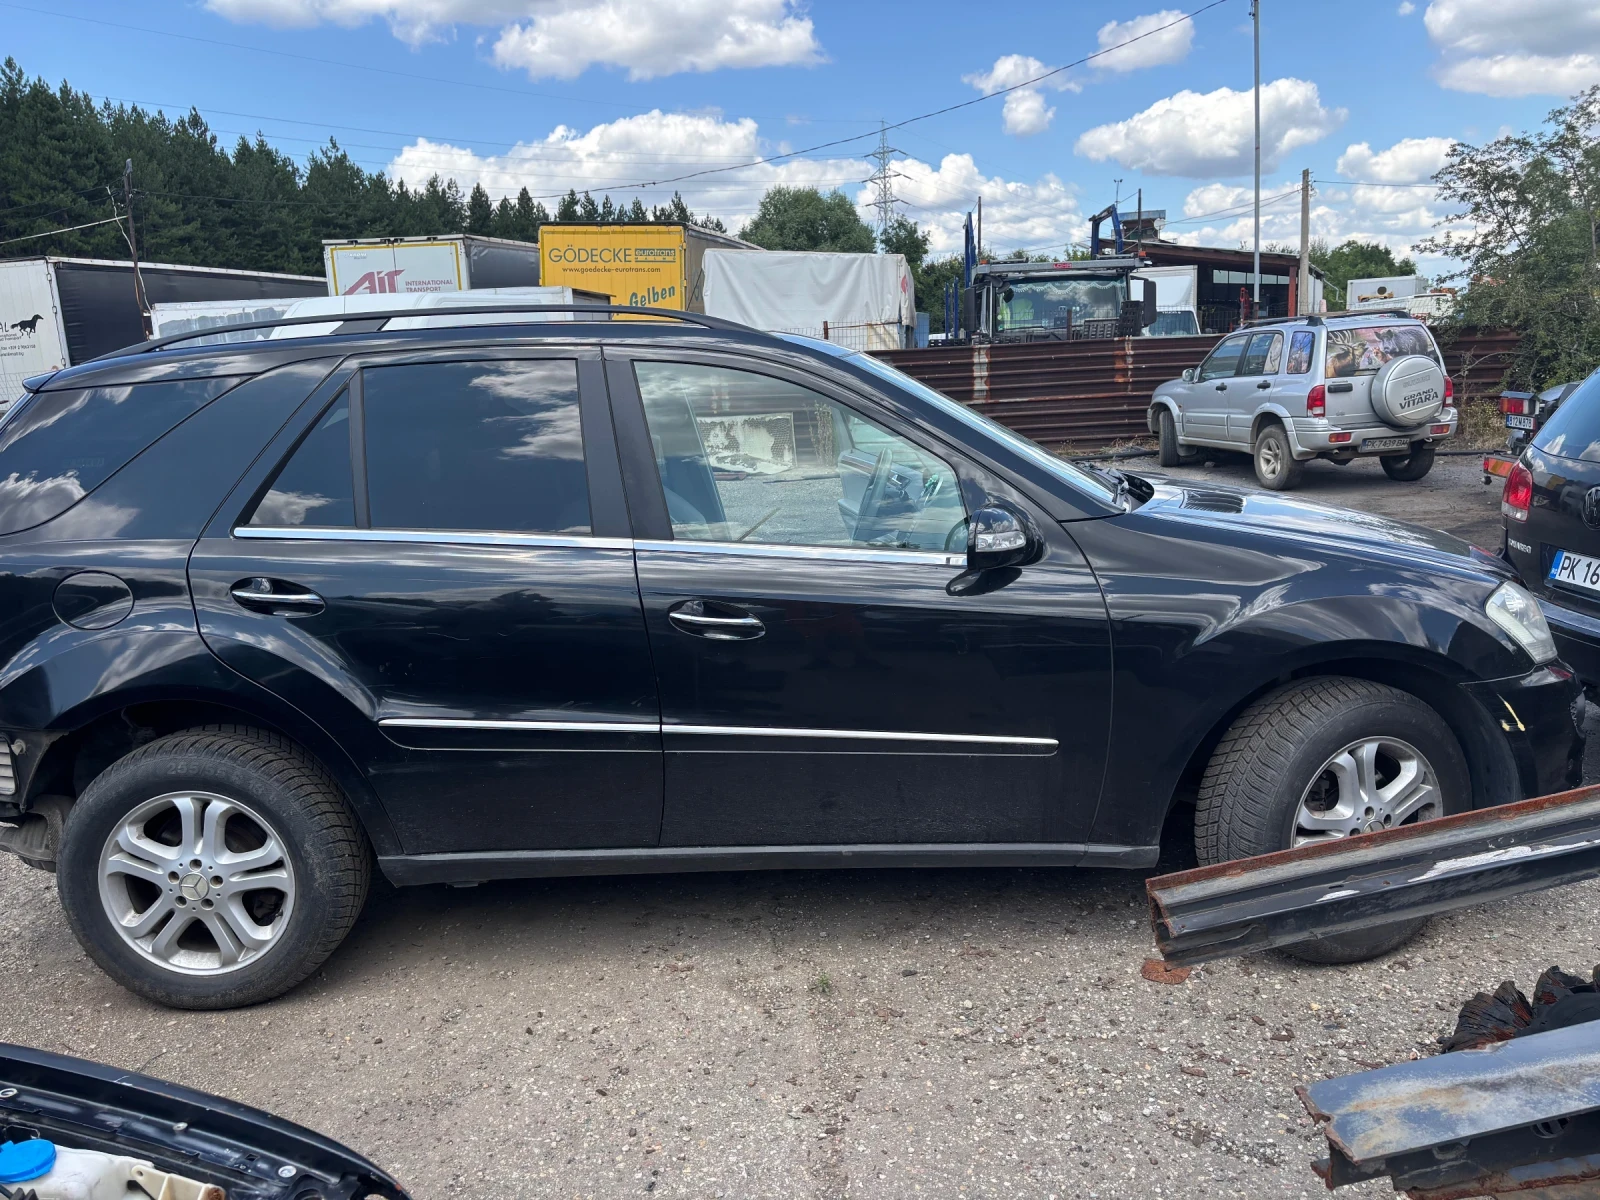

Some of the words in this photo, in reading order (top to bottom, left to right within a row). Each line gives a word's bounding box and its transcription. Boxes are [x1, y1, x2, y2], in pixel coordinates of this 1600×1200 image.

[549, 244, 632, 263] GÖDECKE
[635, 248, 675, 256] eurotrans
[562, 266, 661, 274] www.goedecke-eurotrans.com
[405, 279, 453, 287] INTERNATIONAL
[629, 285, 676, 307] Gelben
[1398, 391, 1439, 410] VITARA
[1403, 387, 1434, 401] GRAND
[1558, 556, 1582, 580] PK
